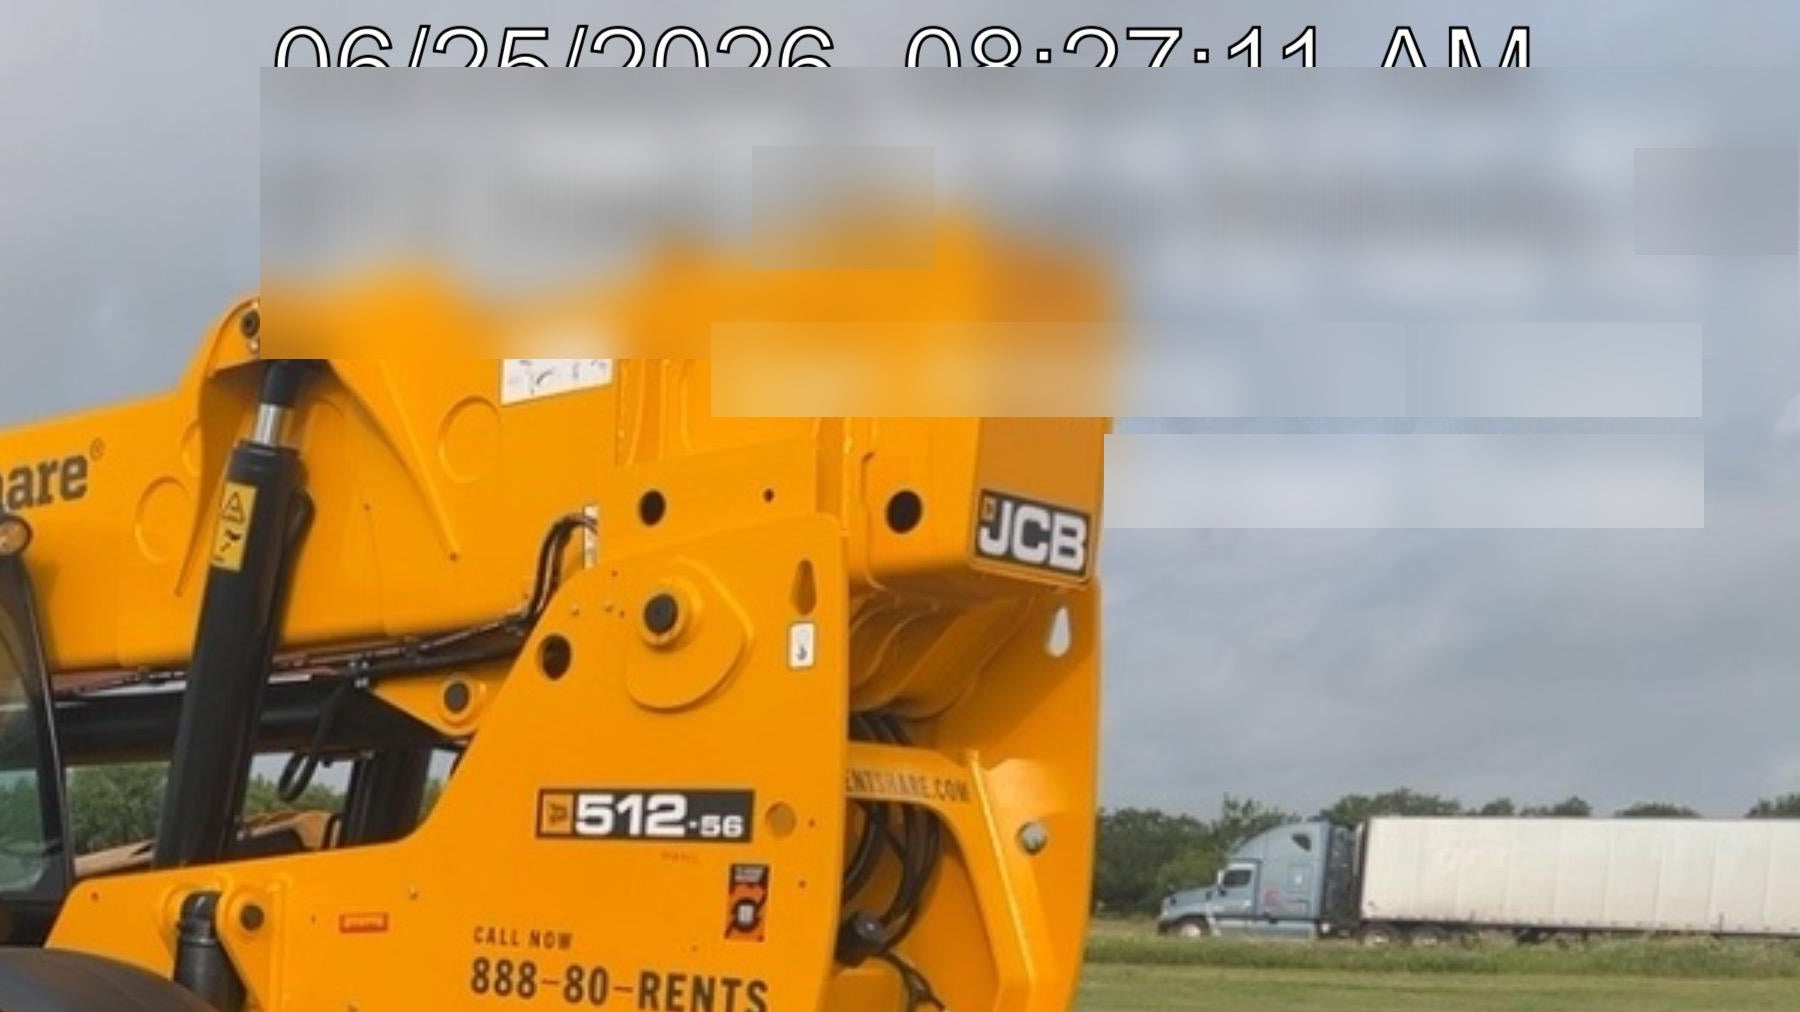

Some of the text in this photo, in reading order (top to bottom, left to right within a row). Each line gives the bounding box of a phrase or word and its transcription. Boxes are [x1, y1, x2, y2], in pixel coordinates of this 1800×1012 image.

[978, 499, 1088, 571] JCB
[473, 926, 572, 950] CALL NOW
